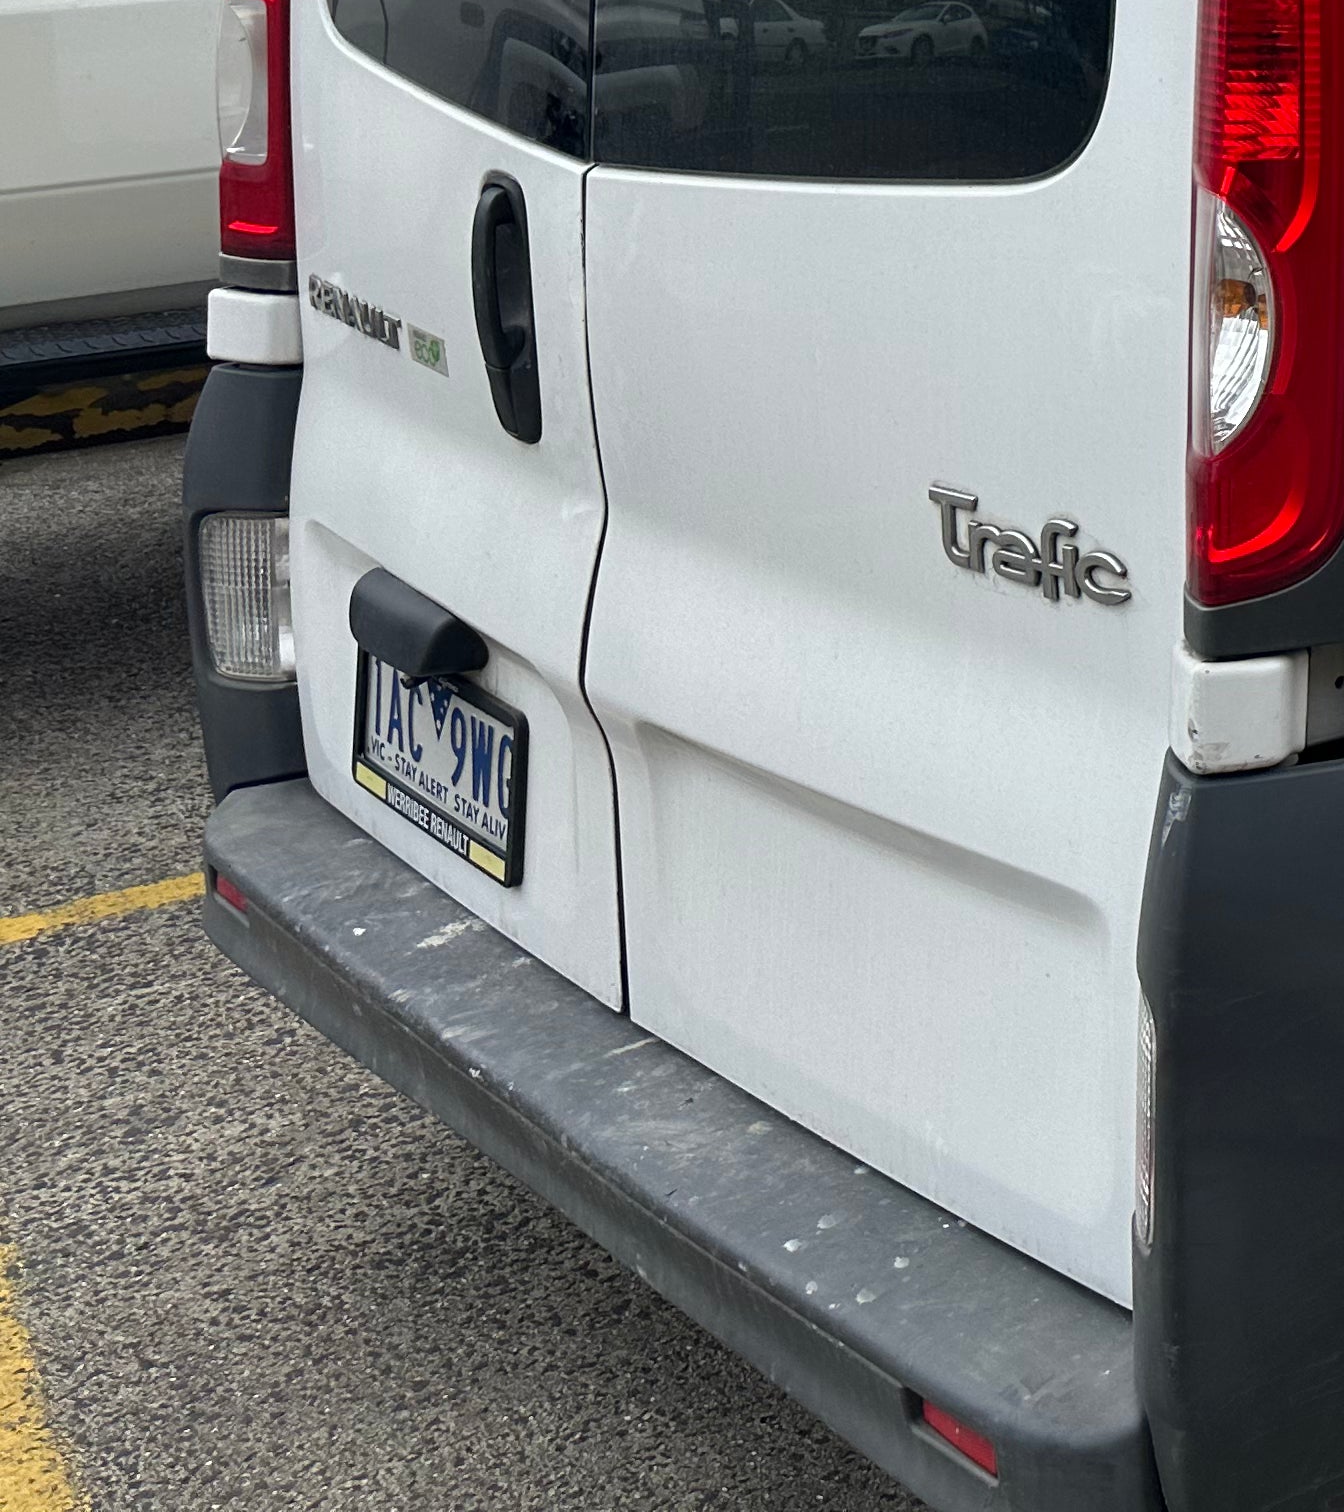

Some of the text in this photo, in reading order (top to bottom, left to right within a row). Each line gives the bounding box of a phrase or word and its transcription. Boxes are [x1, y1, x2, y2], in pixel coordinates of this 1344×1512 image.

[308, 273, 403, 350] RENAULT
[928, 485, 1132, 605] Trafic
[371, 736, 386, 761] VIC
[395, 753, 418, 782] STAY
[418, 771, 449, 804] ALERT
[454, 794, 480, 825] STAY
[481, 812, 507, 841] ALIV
[387, 782, 470, 855] WERRIBEE RENAULT
